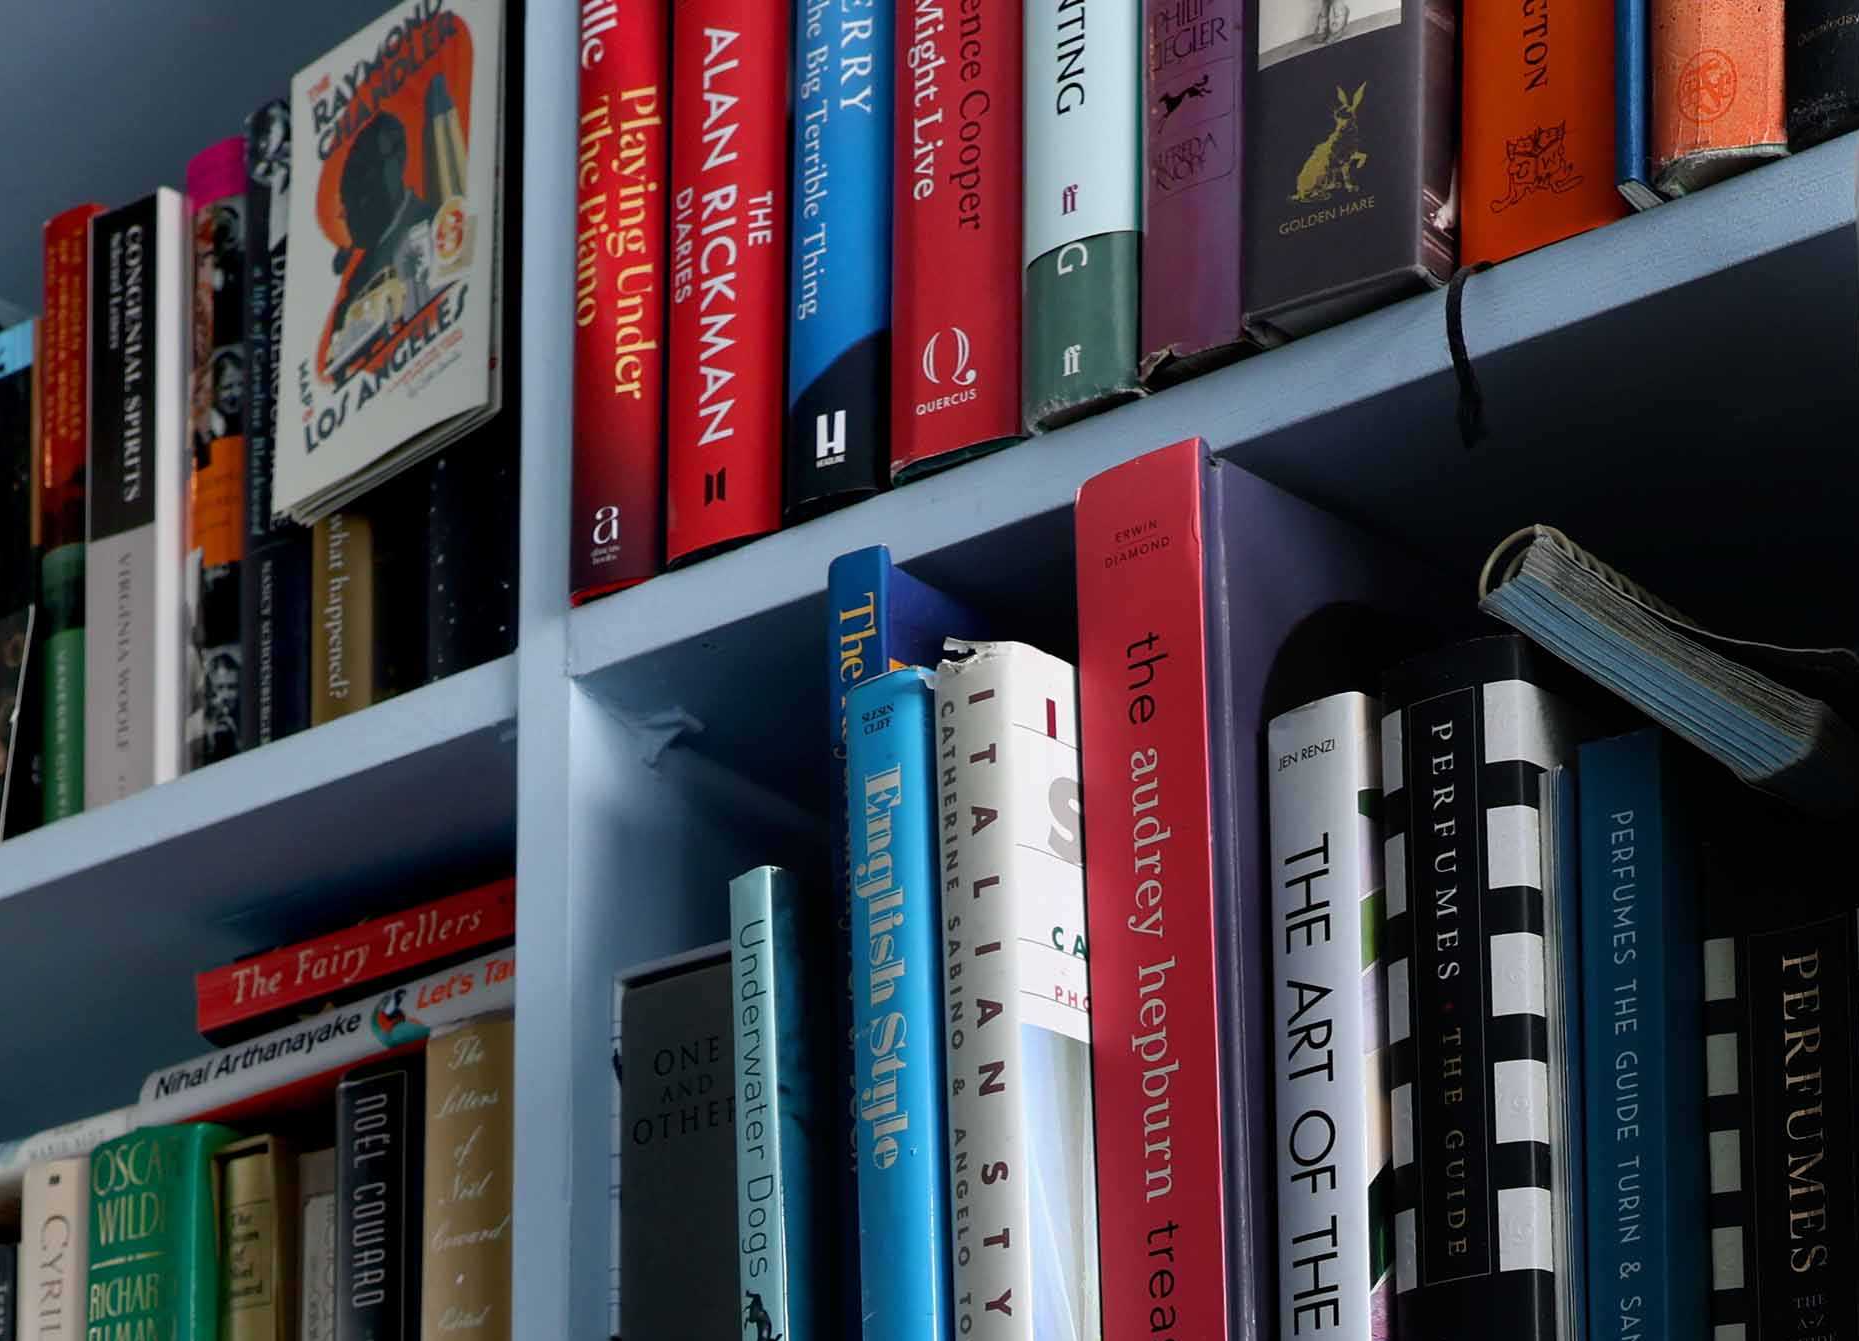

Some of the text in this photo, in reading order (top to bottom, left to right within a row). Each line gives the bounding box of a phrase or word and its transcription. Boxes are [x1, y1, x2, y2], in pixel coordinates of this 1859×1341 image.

[576, 95, 613, 327] The Piano
[606, 85, 661, 400] Playing Under
[675, 187, 694, 304] DIARIES
[697, 27, 740, 446] ALAN RICKMAN
[746, 191, 773, 246] THE
[1278, 195, 1376, 236] GOLDEN HARE
[122, 224, 142, 504] CONGENIAL SPIRITS
[915, 388, 977, 416] QUERCUS
[1104, 534, 1171, 569] DIAMOND
[1114, 519, 1158, 543] ERWIN
[116, 551, 133, 750] VIRGINIA WOOLF
[1127, 630, 1169, 727] the
[1277, 739, 1336, 772] JEN RENZI
[1128, 748, 1172, 939] audrey
[1284, 831, 1331, 954] THE
[1430, 720, 1461, 981] PERFUMES
[1610, 810, 1636, 966] PERFUMES
[230, 904, 486, 1008] The Fairy Tellers
[856, 763, 913, 1169] English Style
[153, 1009, 363, 1100] Nihal Arthanayake
[1286, 980, 1336, 1081] ART
[1613, 982, 1637, 1036] THE
[1128, 954, 1180, 1203] hepburn
[1615, 1050, 1639, 1143] GUIDE
[1781, 948, 1828, 1273] PERFUMES
[1288, 1111, 1337, 1193] OF
[1617, 1155, 1640, 1243] TURIN
[1292, 1215, 1340, 1336] THE
[1618, 1261, 1642, 1281] &
